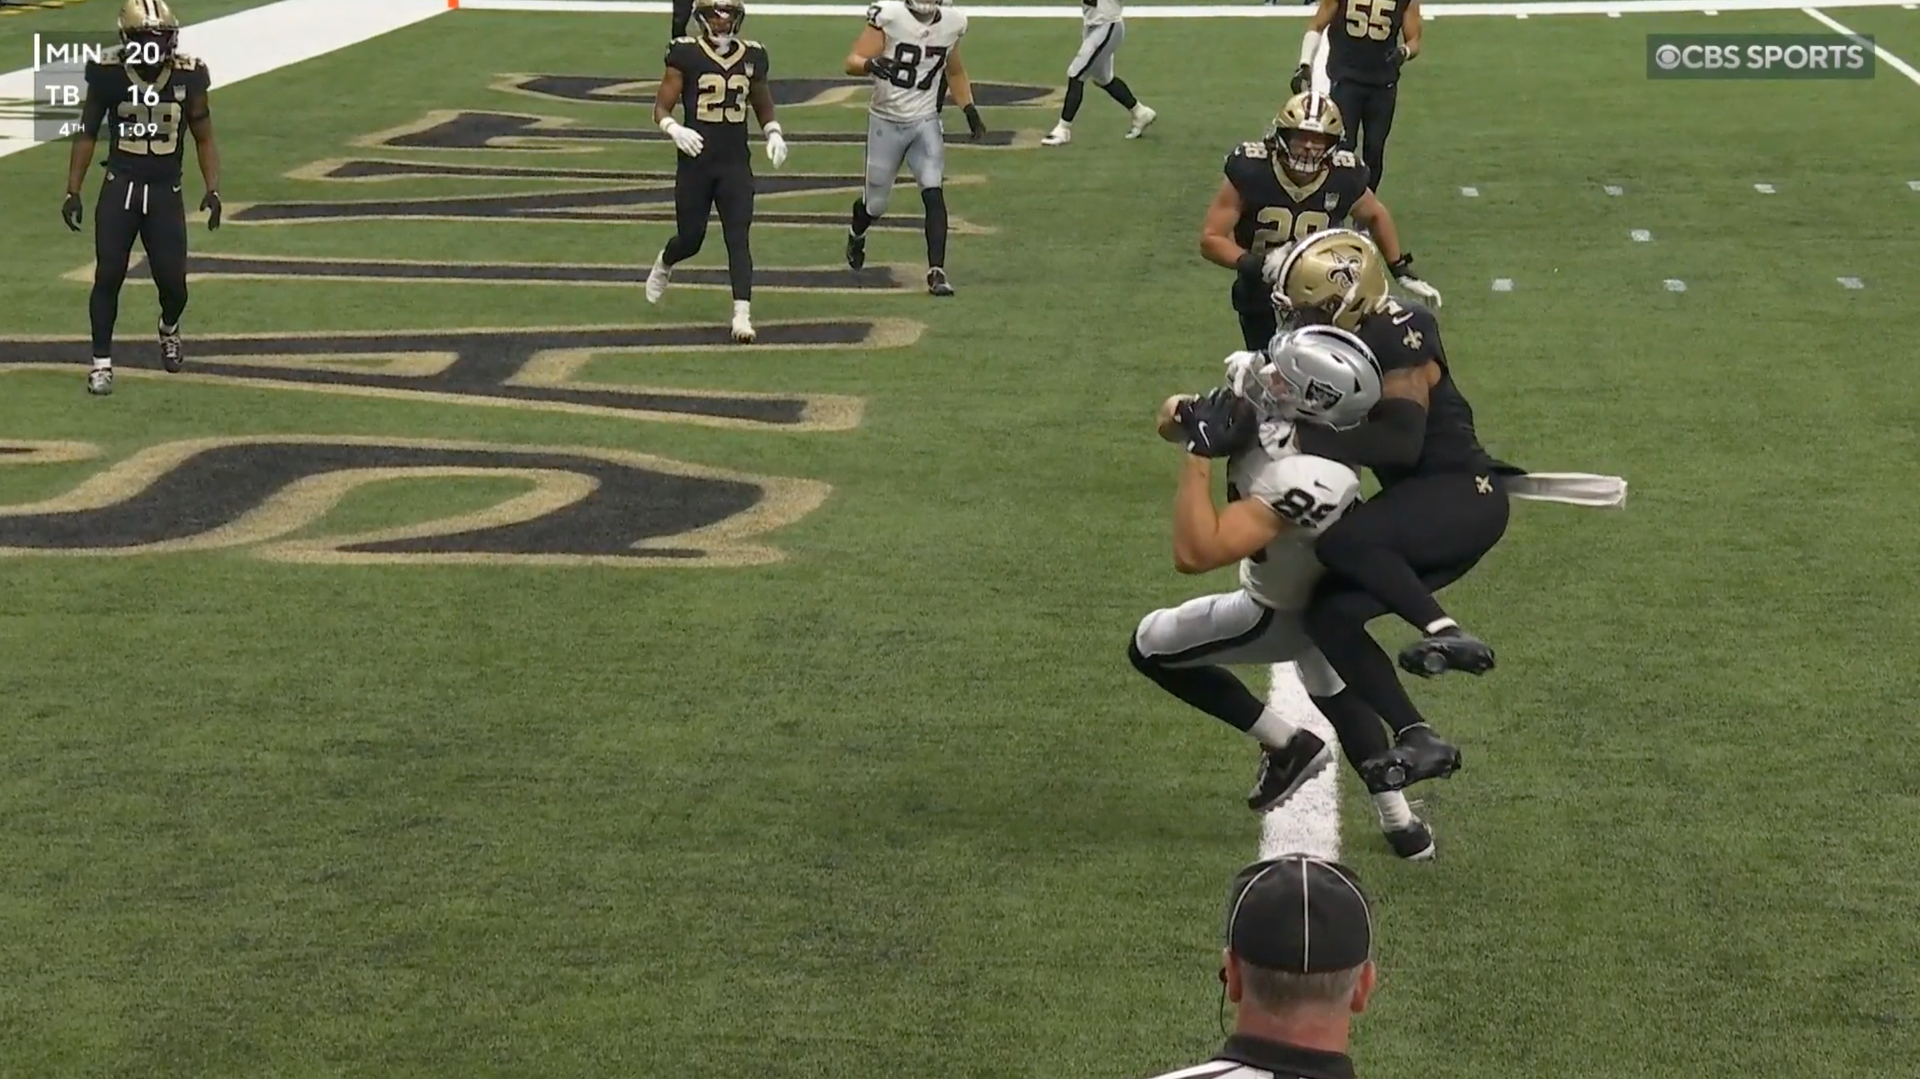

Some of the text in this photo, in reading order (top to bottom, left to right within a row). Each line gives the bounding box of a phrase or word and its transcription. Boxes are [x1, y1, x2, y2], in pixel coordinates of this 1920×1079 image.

[1345, 0, 1397, 41] 55
[888, 43, 948, 91] 87
[696, 73, 750, 123] 23
[117, 100, 183, 155] 29
